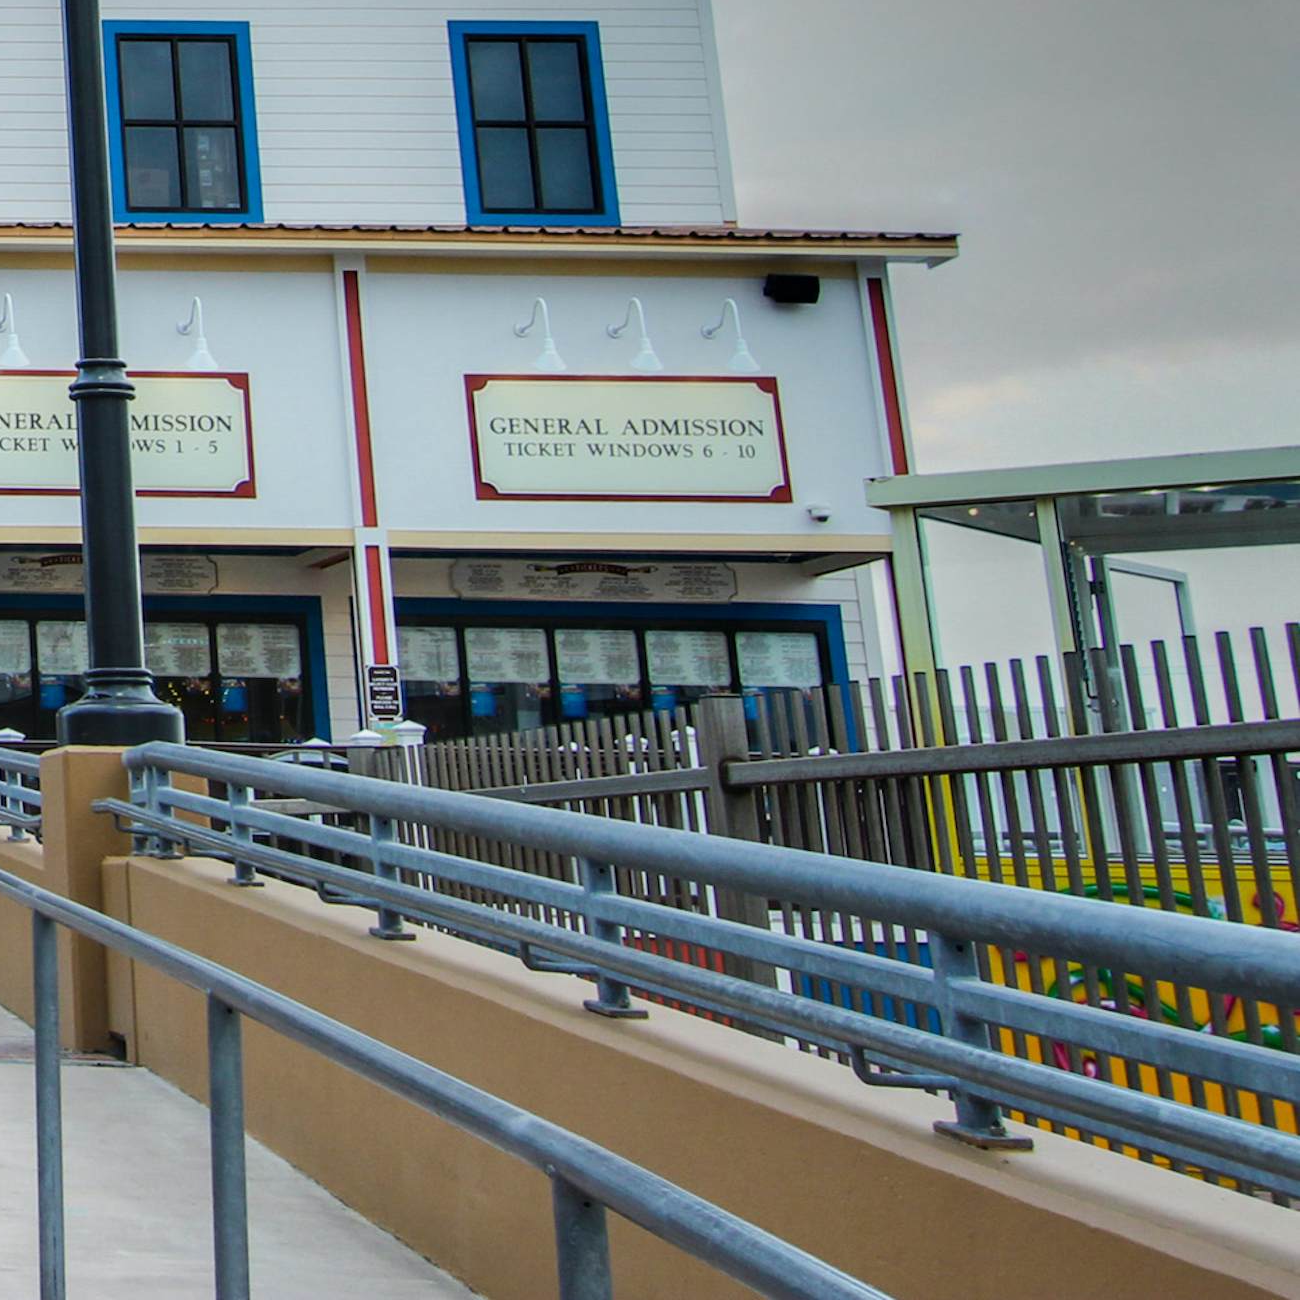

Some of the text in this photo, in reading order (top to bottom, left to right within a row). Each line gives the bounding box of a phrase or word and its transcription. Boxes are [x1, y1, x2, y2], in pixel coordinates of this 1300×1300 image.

[489, 417, 765, 437] GENERAL ADMISSION
[175, 440, 183, 453] 1
[208, 440, 218, 454] 5
[503, 442, 576, 457] TICKET
[587, 443, 694, 458] WINDOWS
[702, 444, 713, 458] 6
[737, 444, 756, 459] 10
